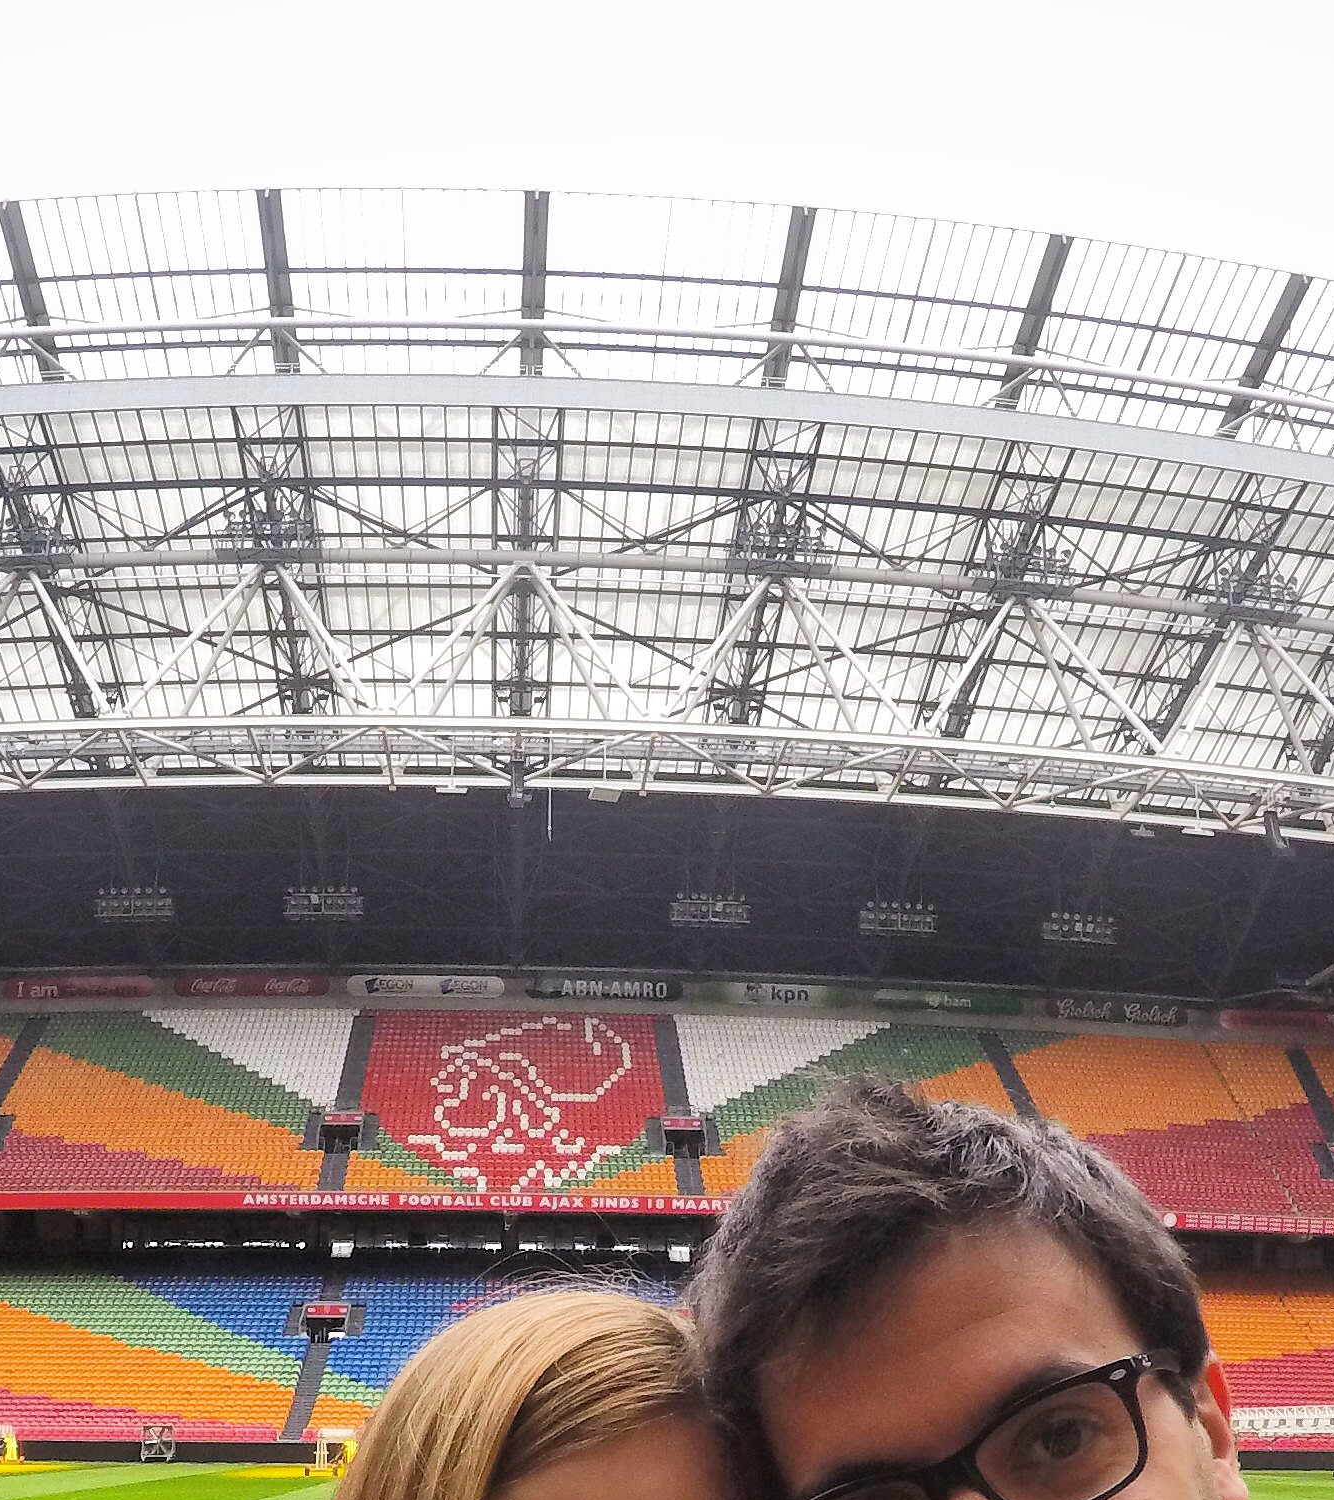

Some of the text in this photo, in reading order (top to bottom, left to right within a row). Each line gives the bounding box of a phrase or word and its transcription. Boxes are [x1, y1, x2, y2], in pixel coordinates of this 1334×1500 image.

[17, 981, 25, 998] I
[29, 984, 59, 998] am
[771, 986, 809, 1003] kpn
[1057, 999, 1179, 1023] Grolsch Grolsch
[242, 1193, 732, 1212] AMSTERDAMSCHE FOOTBALL CLUB AJAX SINDS 18 MAART
